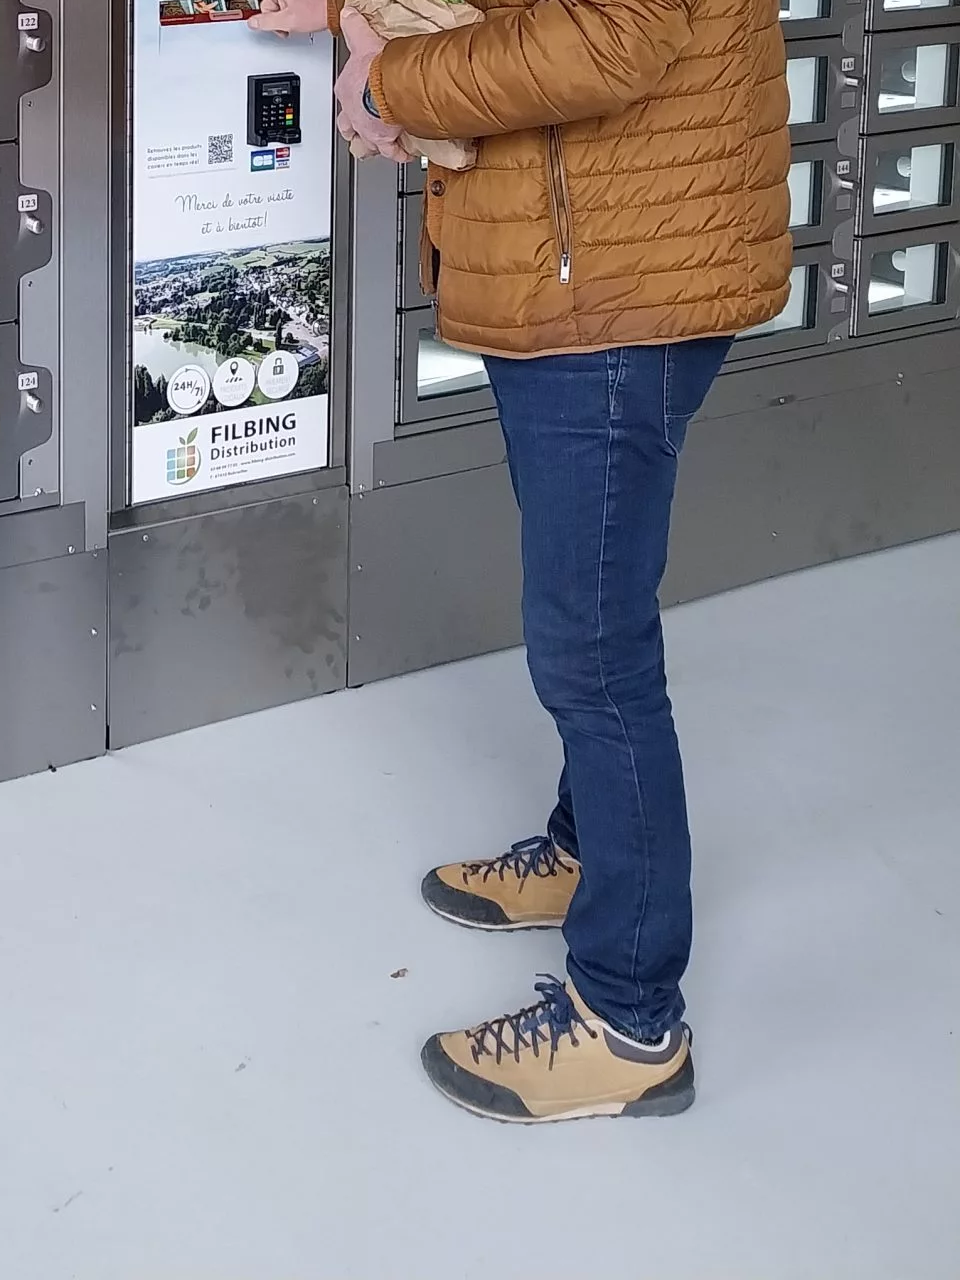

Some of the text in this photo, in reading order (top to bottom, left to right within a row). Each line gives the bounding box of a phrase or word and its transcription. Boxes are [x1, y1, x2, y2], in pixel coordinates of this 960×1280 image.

[19, 16, 36, 27] 122
[19, 198, 36, 208] 123
[174, 188, 295, 213] Merci de votre visite
[201, 222, 212, 235] et
[215, 221, 224, 233] à
[20, 377, 36, 387] 124
[211, 413, 297, 444] FILBING
[210, 435, 296, 461] Distribution
